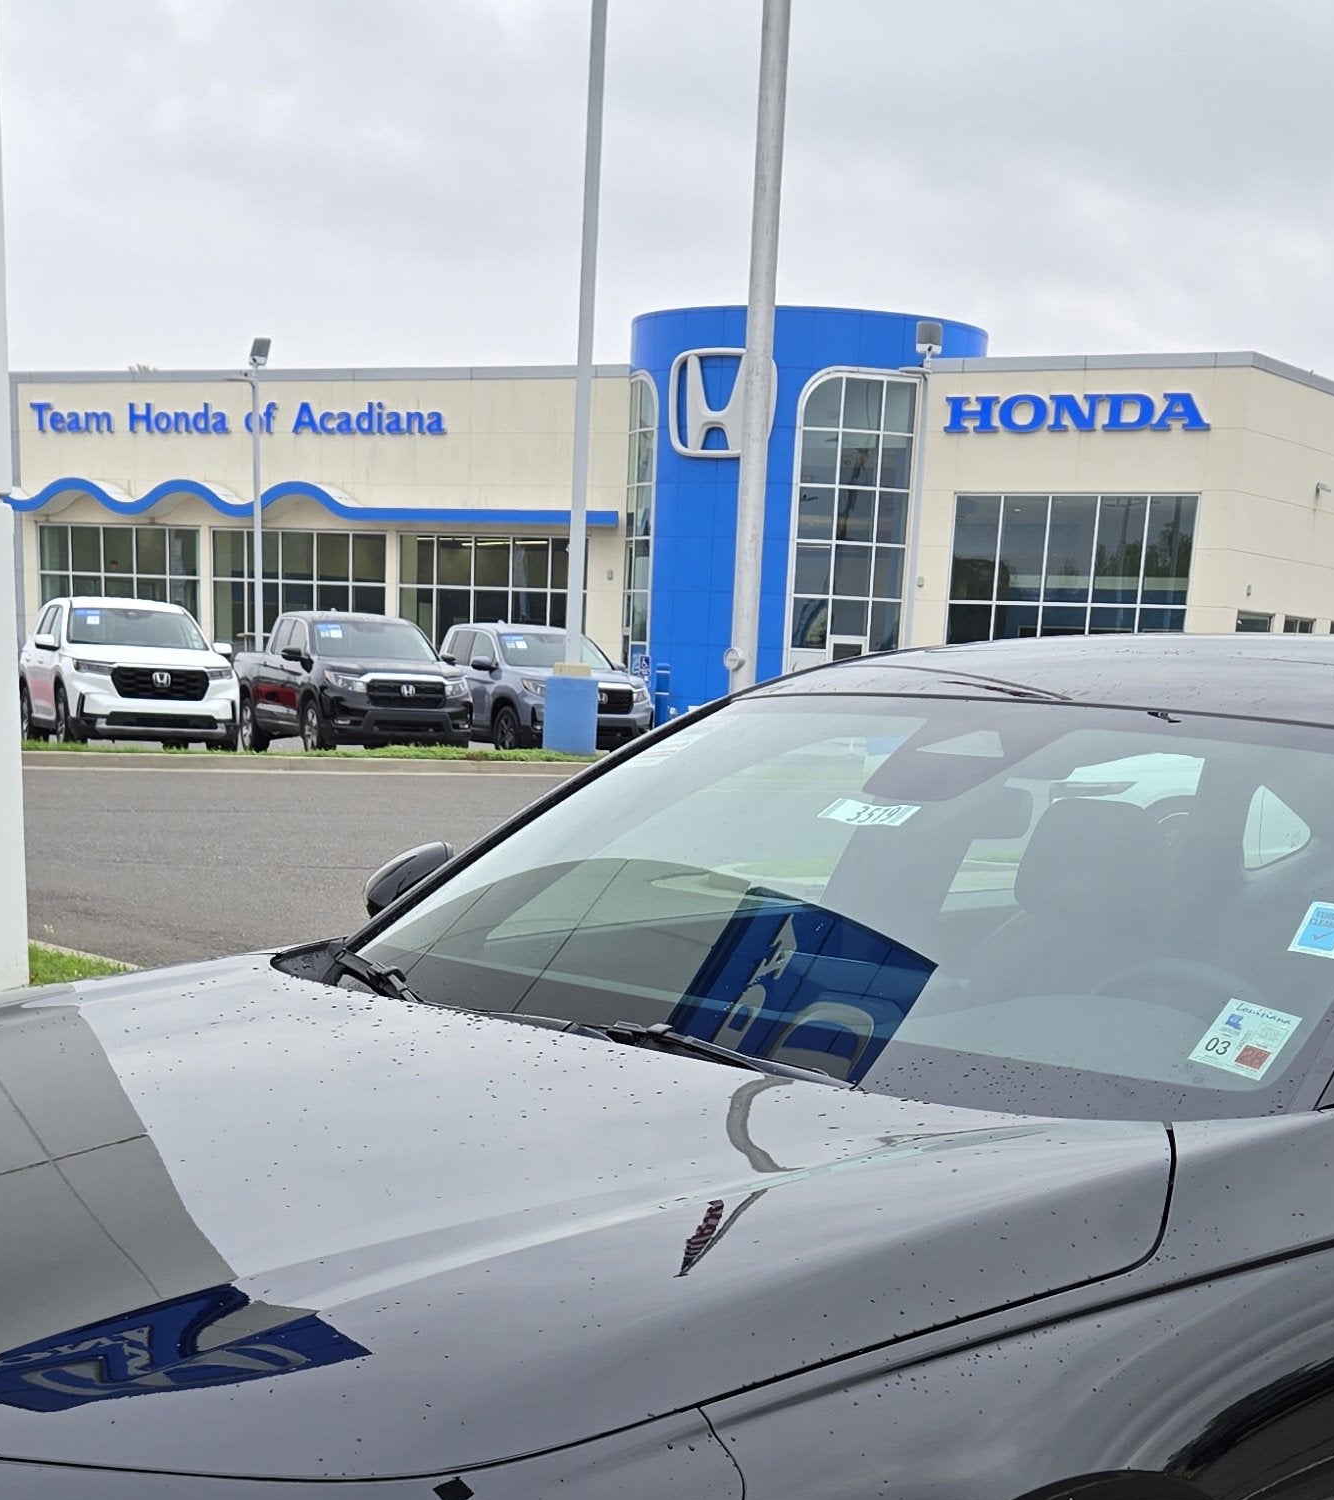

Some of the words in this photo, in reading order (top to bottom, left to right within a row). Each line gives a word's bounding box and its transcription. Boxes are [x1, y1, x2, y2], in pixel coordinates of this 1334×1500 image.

[30, 402, 114, 434] Team
[128, 402, 231, 434] Honda
[292, 402, 447, 435] Acadiana
[943, 393, 1211, 433] HONDA
[846, 806, 903, 824] 3519
[1236, 1003, 1291, 1024] Louisiana
[1205, 1037, 1231, 1055] 03
